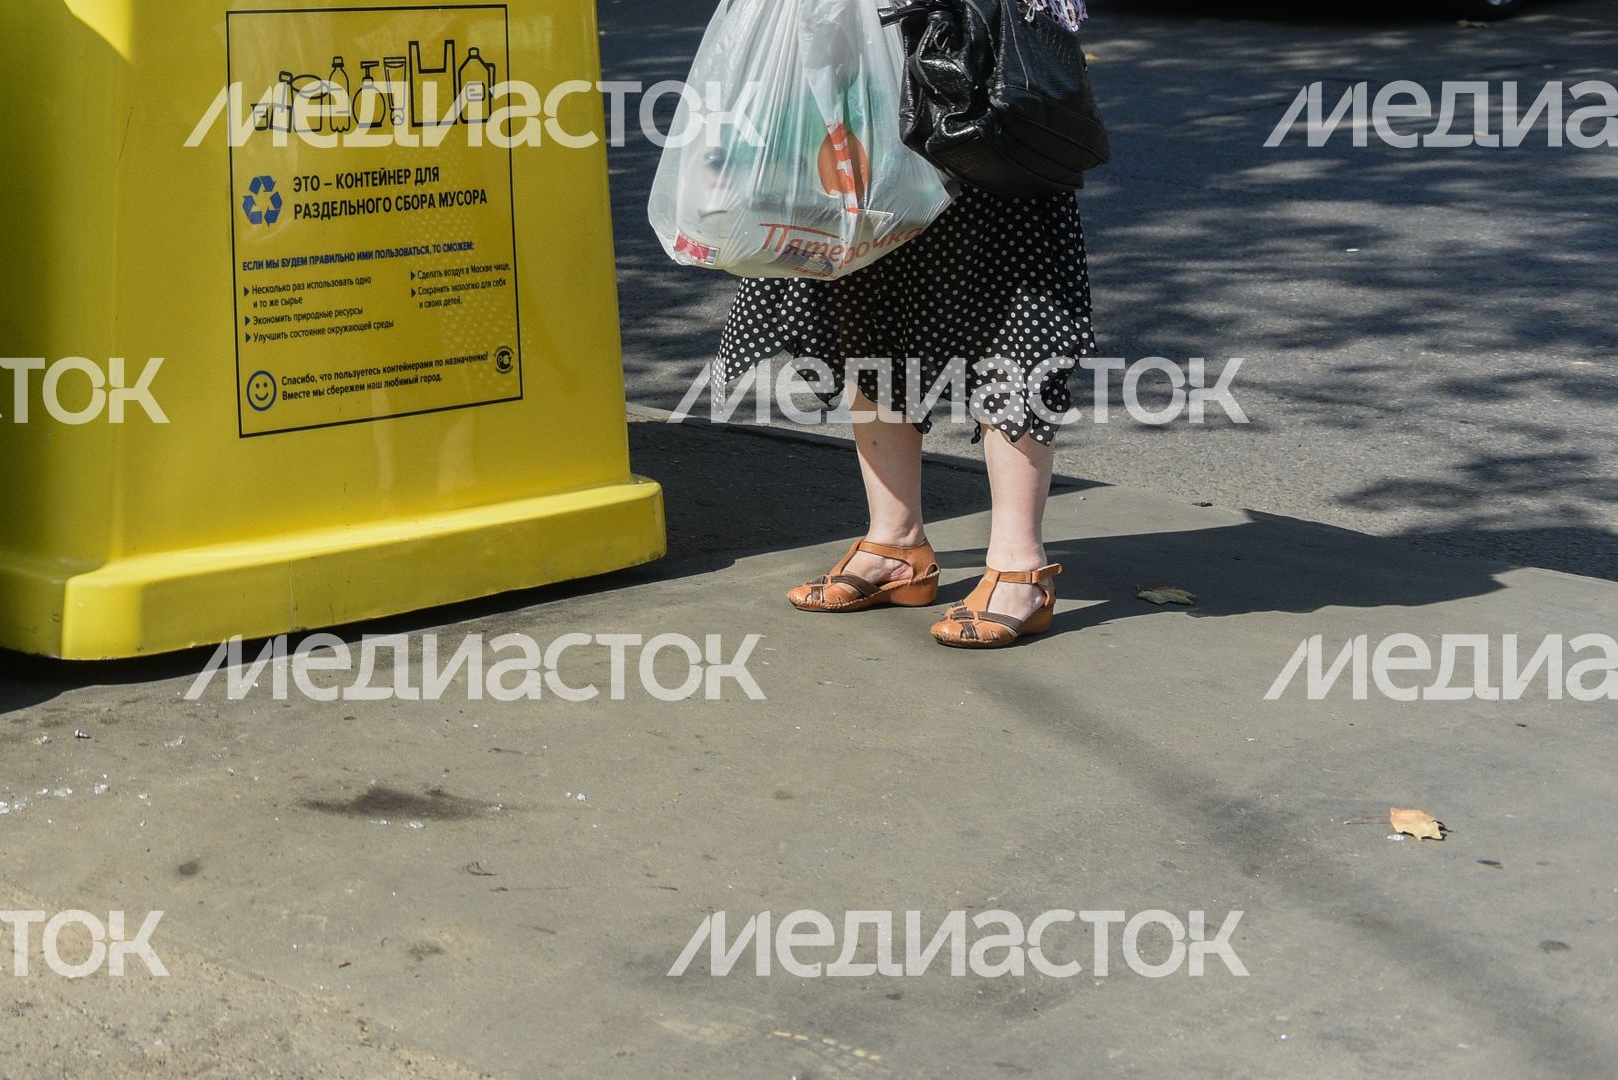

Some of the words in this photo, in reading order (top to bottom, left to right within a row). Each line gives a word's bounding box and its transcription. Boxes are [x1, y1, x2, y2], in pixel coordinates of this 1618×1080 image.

[293, 174, 320, 192] ЭТО
[335, 168, 410, 189] КОНТЕЙНЕР
[414, 166, 439, 185] ДЛЯ
[294, 196, 391, 219] РАЗДЕЛЬНОГО
[395, 193, 435, 211] СБОРА
[438, 188, 486, 207] МУСОРА
[242, 260, 263, 270] ЕСЛИ
[265, 259, 279, 268] МЫ
[281, 257, 307, 267] БУДЕМ
[309, 252, 354, 264] ПРАВИЛЬНО
[356, 251, 373, 259] ИМИ
[374, 245, 431, 258] ПОЛЬЗОВАТЬСЯ,
[432, 244, 440, 253] ТО
[442, 241, 474, 252] СМОЖЕМ:
[417, 270, 442, 280] Сделать
[443, 268, 464, 277] воздух
[470, 264, 492, 273] Москве
[251, 284, 290, 294] Несколько
[292, 282, 304, 292] раз
[306, 278, 353, 289] использовать
[354, 276, 371, 285] одно
[418, 285, 449, 296] Сохранить
[451, 282, 479, 291] экологию
[480, 280, 491, 289] для
[492, 277, 505, 287] себя
[269, 298, 278, 306] же
[280, 296, 302, 306] сырье
[424, 299, 441, 308] своих
[443, 295, 462, 306] детей.
[253, 314, 291, 325] Экономить
[293, 310, 332, 322] природные
[334, 307, 362, 318] ресурсы
[253, 331, 288, 343] Улучшить
[289, 327, 325, 338] состояние
[327, 321, 371, 335] окружающей
[373, 320, 393, 329] среды
[281, 373, 317, 385] Спасибо,
[333, 367, 380, 379] пользуетесь
[382, 360, 432, 373] контейнерами
[444, 351, 487, 365] назначению!
[282, 390, 310, 400] Вместе
[312, 388, 324, 396] мы
[326, 383, 364, 395] сбережем
[366, 381, 382, 389] наш
[384, 375, 418, 387] любимый
[420, 373, 442, 384] город.
